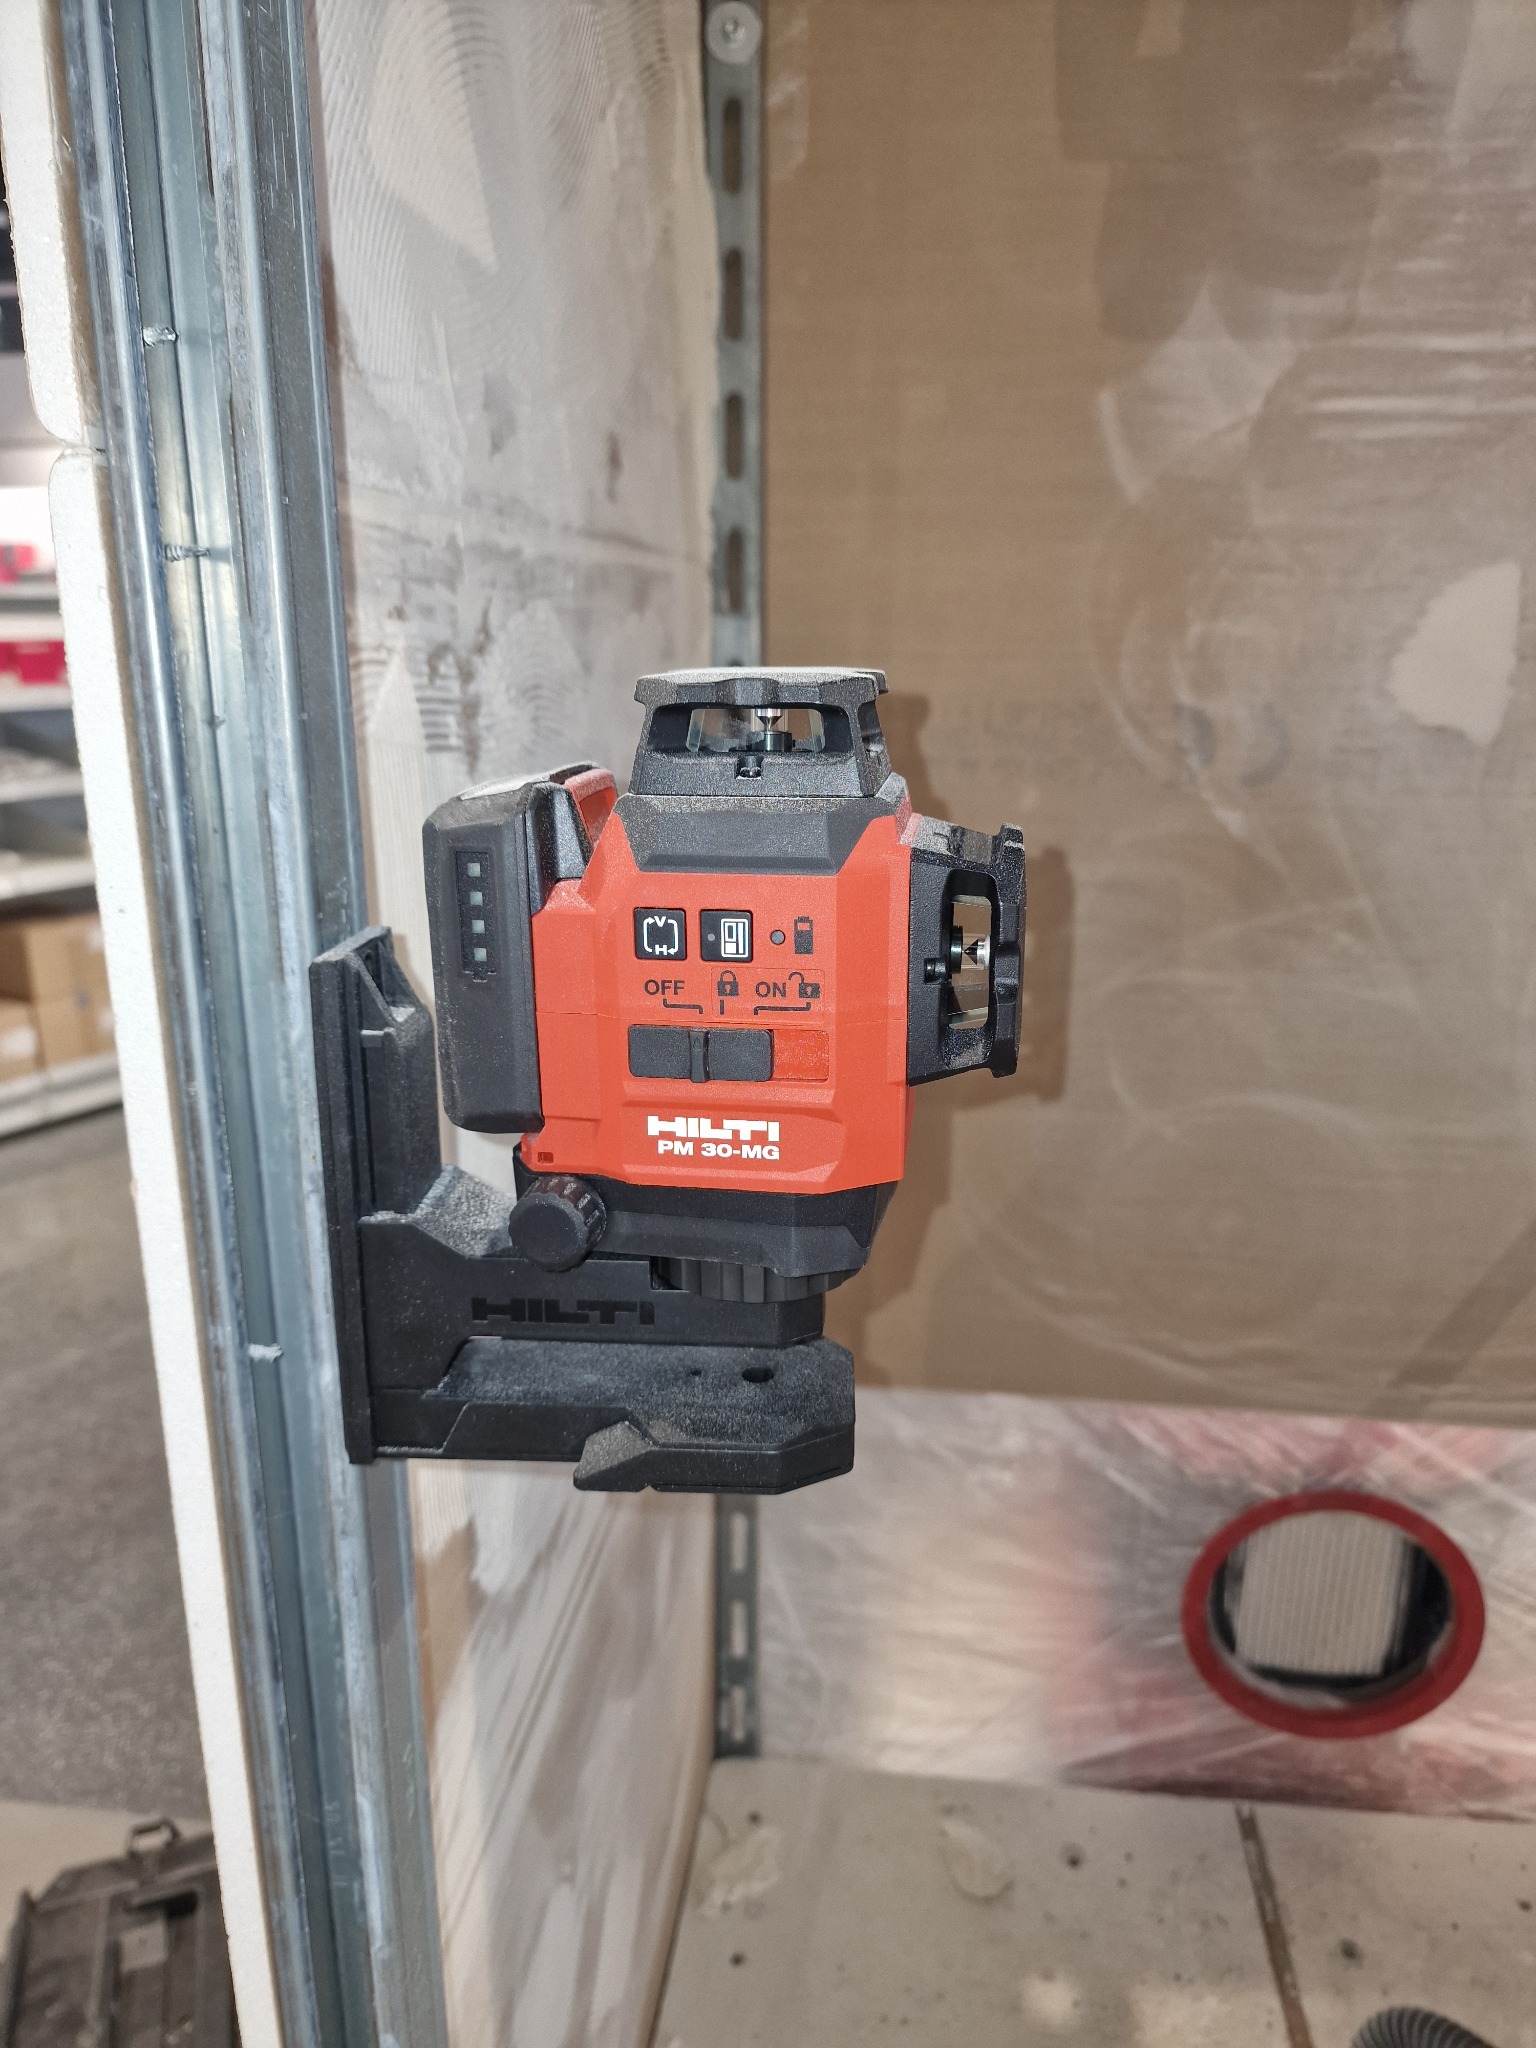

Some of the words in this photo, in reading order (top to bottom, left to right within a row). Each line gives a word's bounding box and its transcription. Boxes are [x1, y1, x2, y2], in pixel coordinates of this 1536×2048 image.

[654, 915, 667, 927] V
[654, 944, 668, 956] H
[644, 979, 685, 996] OFF
[755, 981, 787, 998] ON
[647, 1115, 780, 1142] HILTI
[657, 1139, 694, 1156] PM
[701, 1142, 780, 1160] 30-MG
[472, 1297, 655, 1326] HILTI
